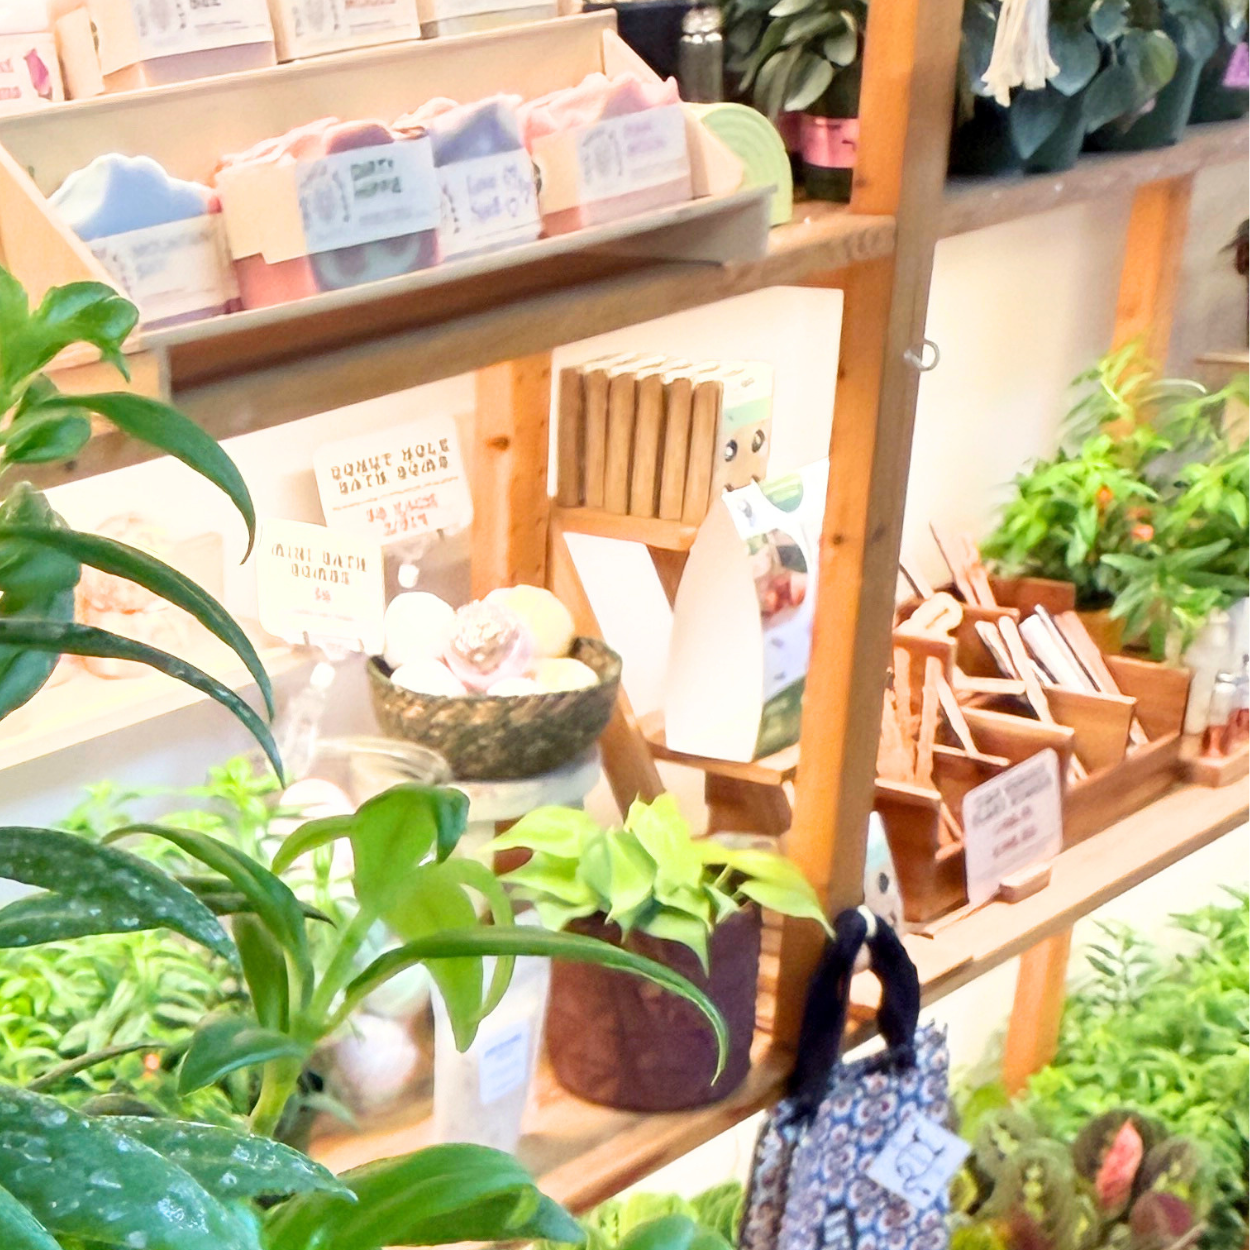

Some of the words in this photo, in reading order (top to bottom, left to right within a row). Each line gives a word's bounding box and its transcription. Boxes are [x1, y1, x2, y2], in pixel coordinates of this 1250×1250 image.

[401, 437, 449, 463] HOLE
[338, 470, 387, 495] BATH
[271, 543, 311, 562] MINI
[322, 550, 367, 573] BATH
[291, 563, 350, 585] BOMBS
